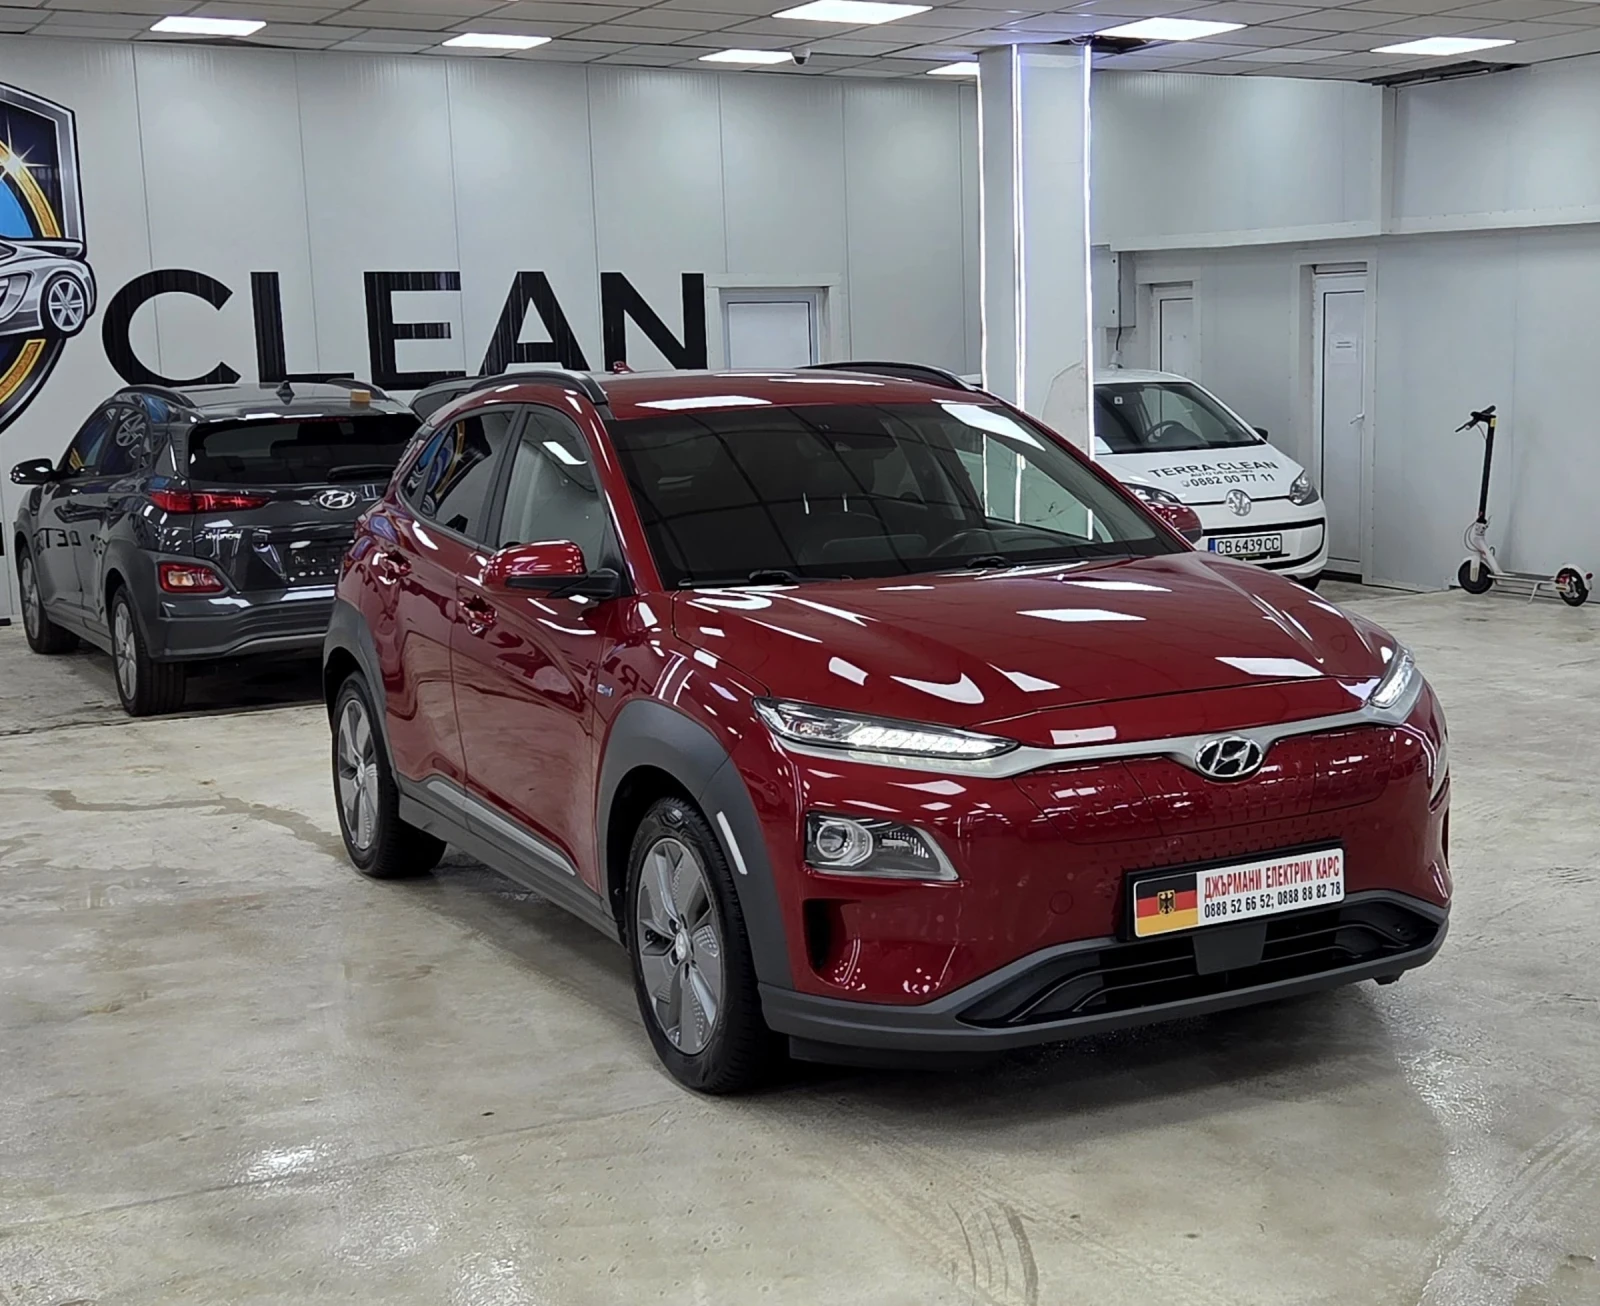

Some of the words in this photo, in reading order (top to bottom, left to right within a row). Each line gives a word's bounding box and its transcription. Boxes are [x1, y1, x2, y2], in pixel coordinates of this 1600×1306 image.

[102, 269, 707, 390] CLEAN
[1148, 464, 1215, 477] TERRA
[1217, 462, 1279, 471] CLEAN
[1190, 475, 1222, 487] 0882
[1224, 475, 1240, 483] 00
[1241, 473, 1257, 481] 77
[1261, 473, 1275, 482] 11
[1217, 540, 1232, 554] CB
[1235, 538, 1262, 553] 6439
[1264, 537, 1279, 551] CC
[1204, 868, 1262, 903] ДЖЪРМАНИ
[1266, 860, 1313, 889] ЕЛЕКТРИК
[1316, 855, 1340, 880] КАРС
[1204, 901, 1227, 918] 0888
[1231, 898, 1242, 914] 52
[1245, 896, 1257, 911] 66
[1260, 893, 1274, 909] 52;
[1277, 888, 1299, 905] 0888
[1302, 886, 1313, 901] 88
[1316, 883, 1327, 898] 82
[1330, 881, 1341, 896] 78
